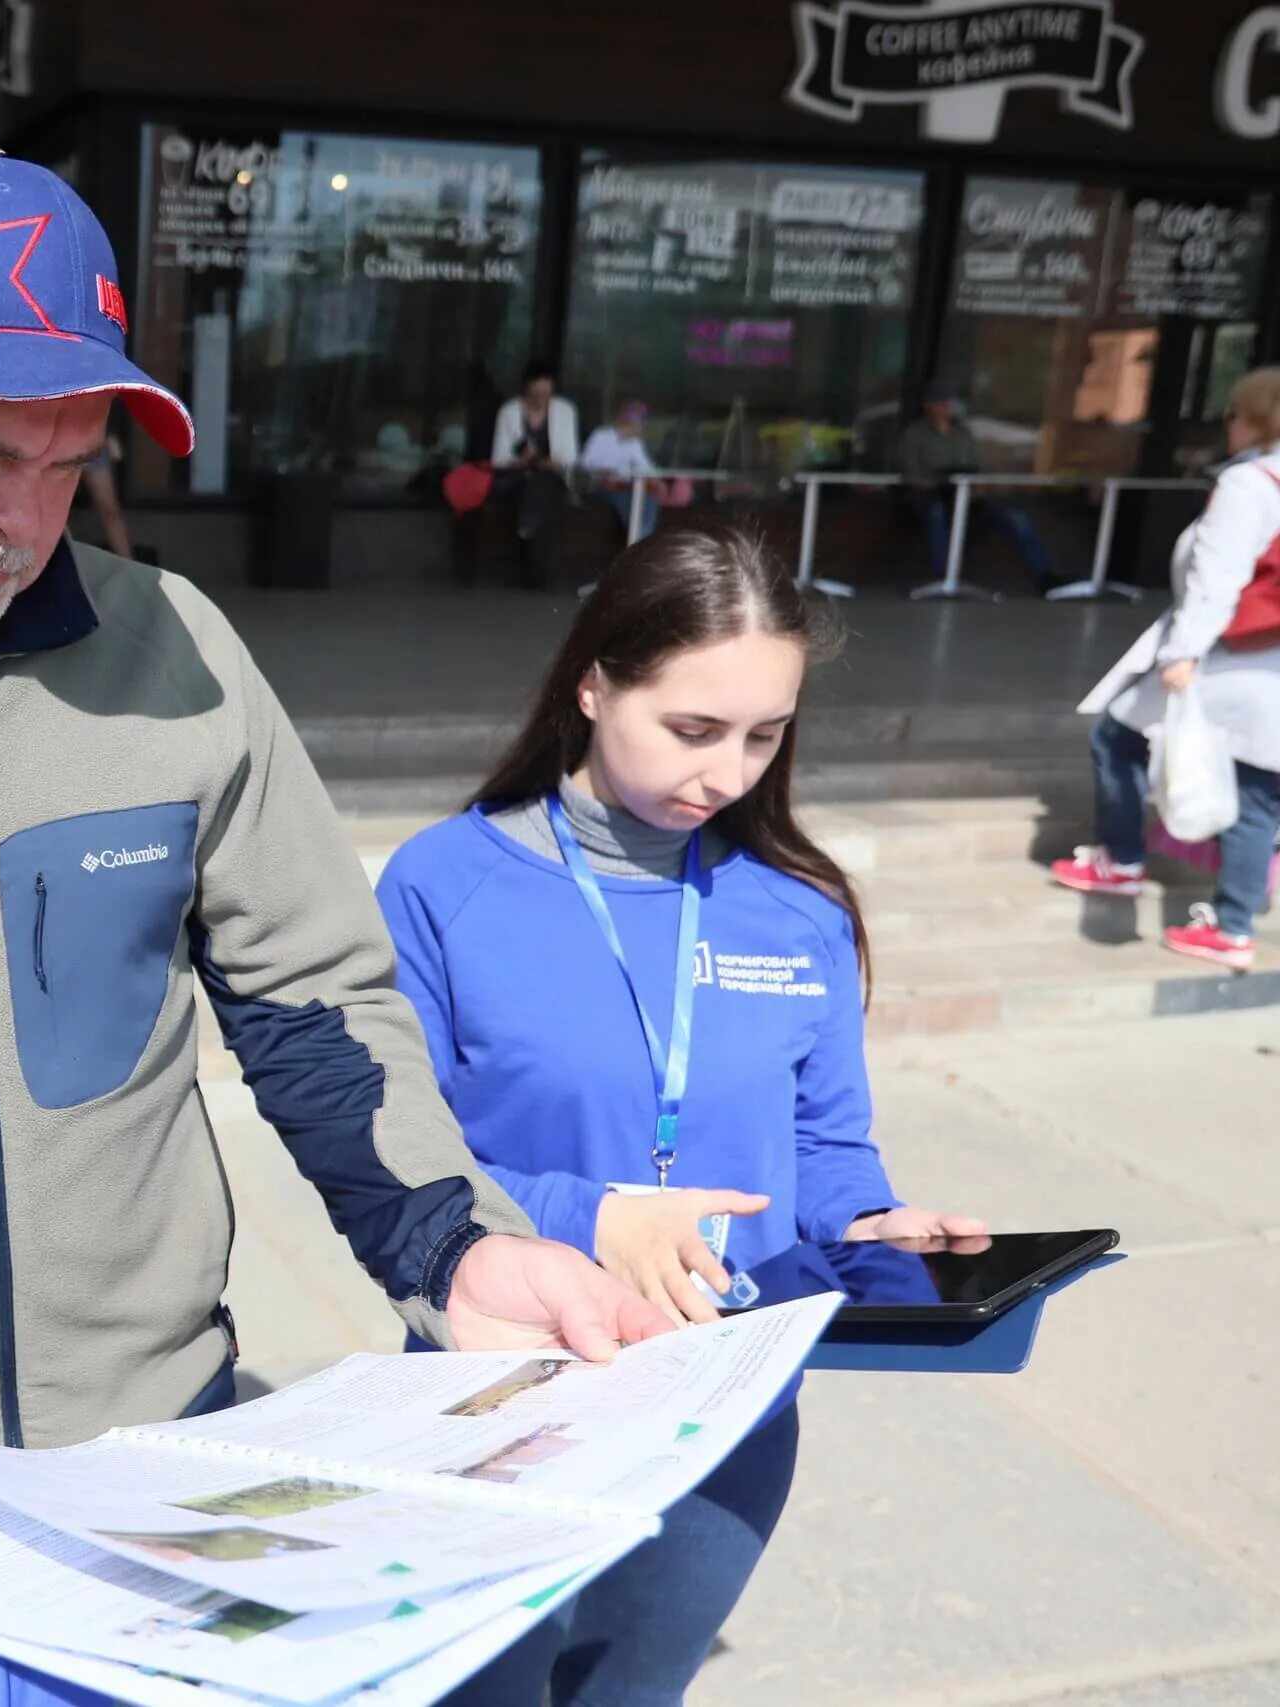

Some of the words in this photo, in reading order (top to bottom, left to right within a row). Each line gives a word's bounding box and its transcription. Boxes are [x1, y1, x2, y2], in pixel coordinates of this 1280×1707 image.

[865, 20, 959, 56] COFFEE
[964, 8, 1081, 45] ANYTIME
[100, 844, 168, 869] Columbia
[714, 954, 811, 969] ФОРМИРОВАНИЕ
[716, 966, 794, 983] КОМФОРТНОЙ
[784, 982, 827, 997] СРЕДЫ
